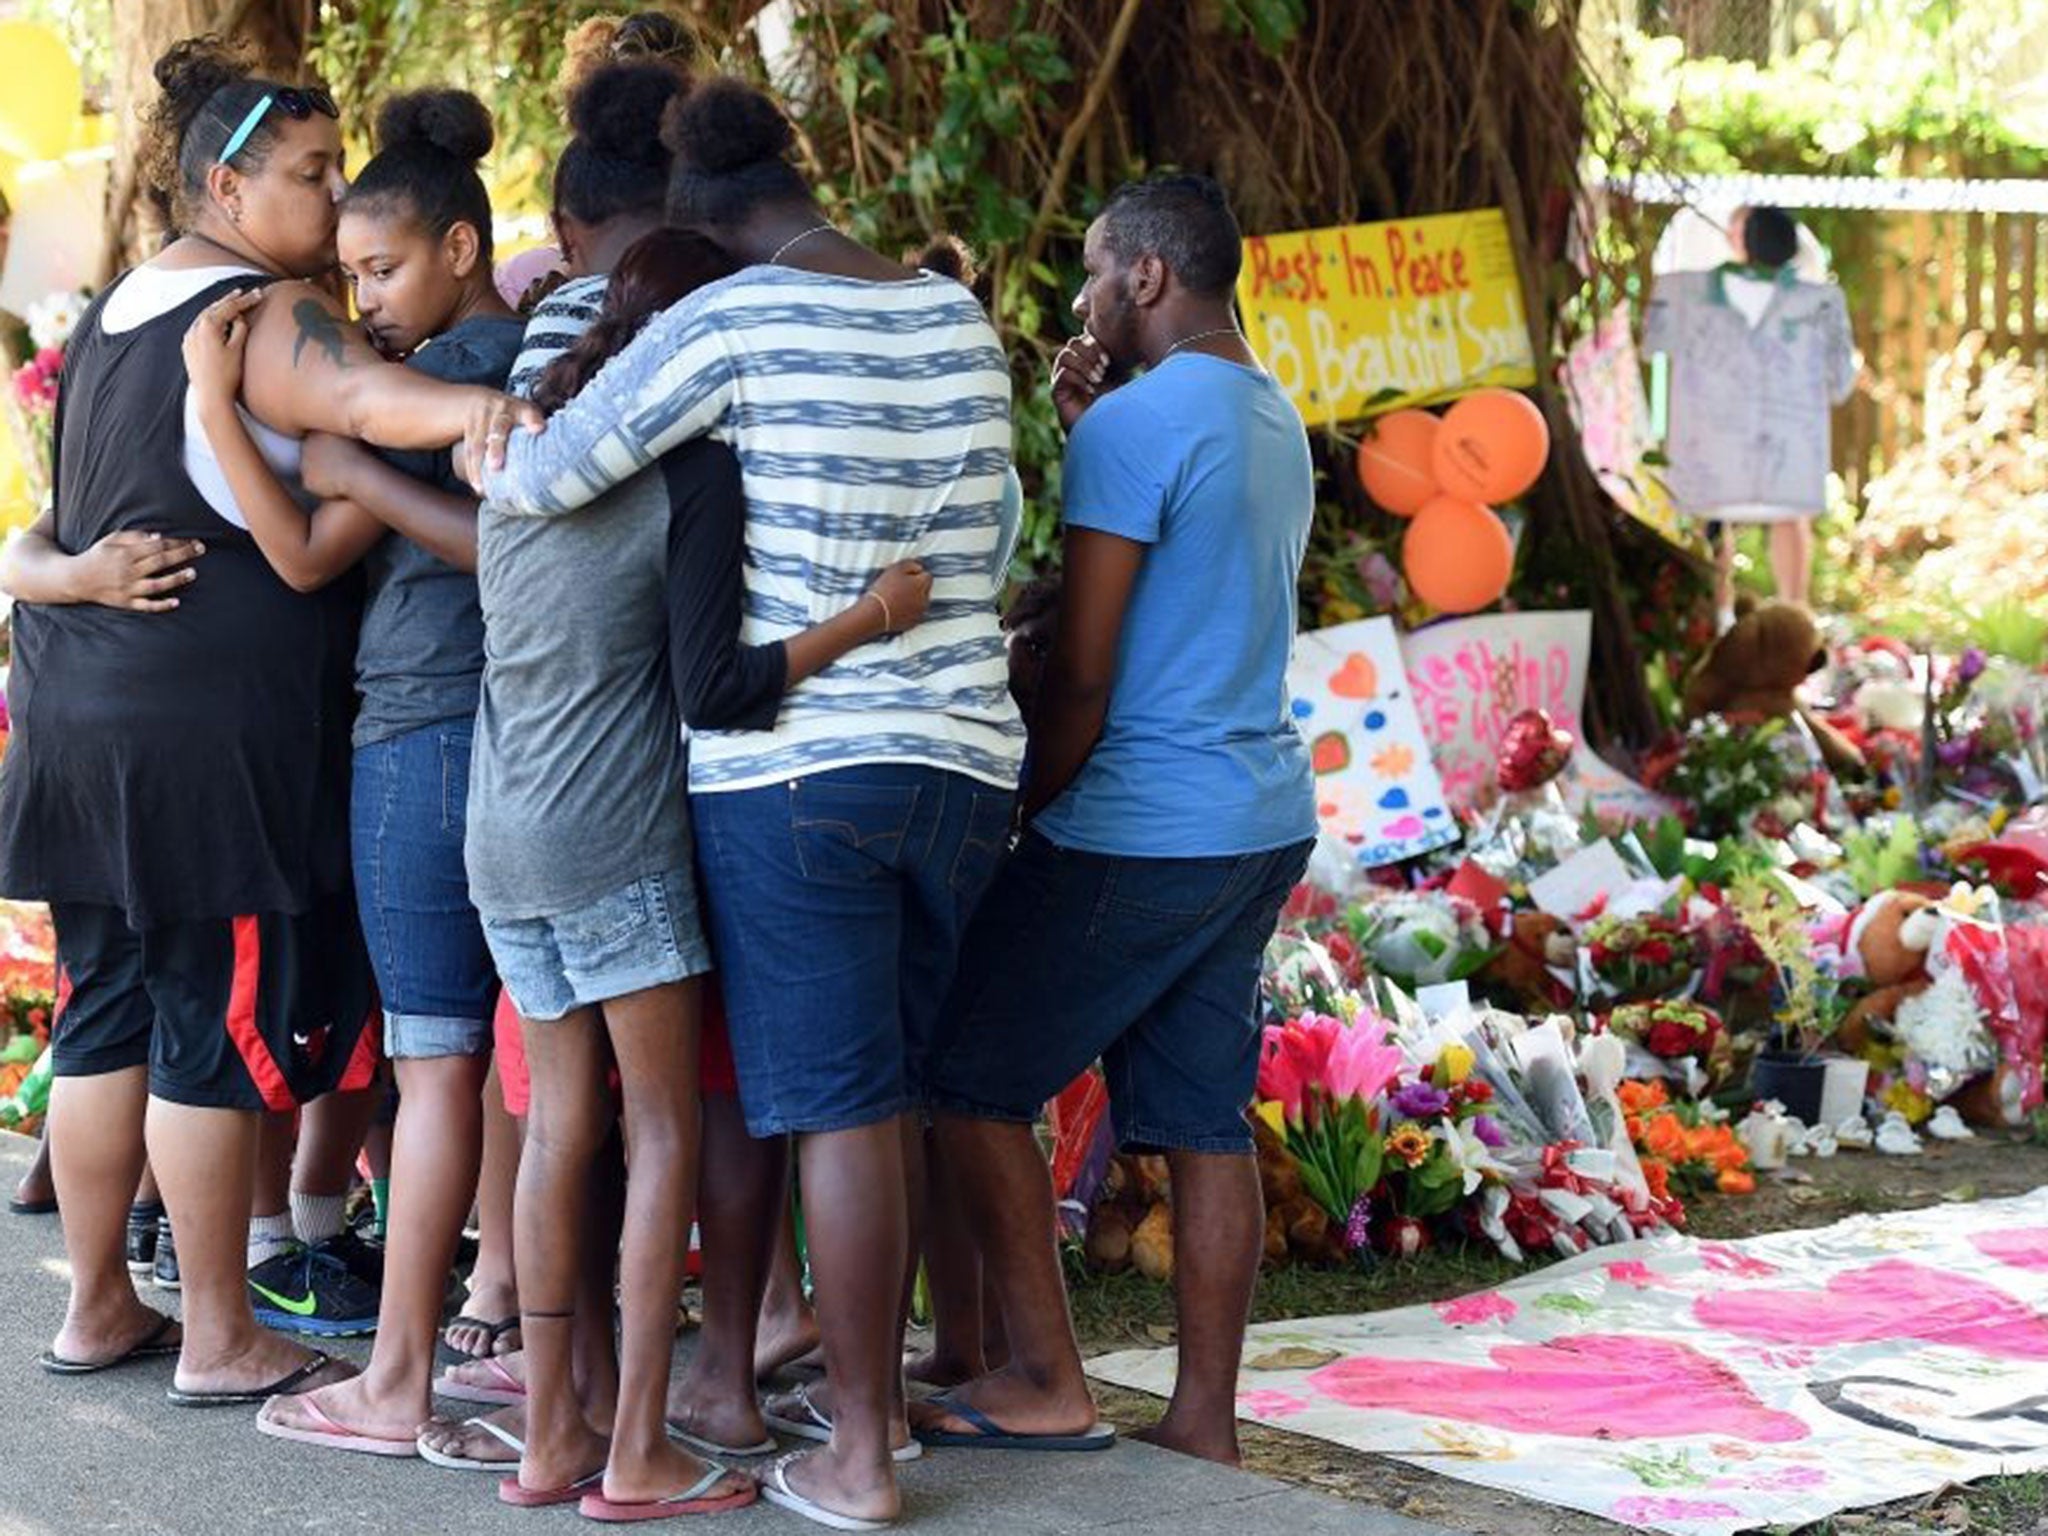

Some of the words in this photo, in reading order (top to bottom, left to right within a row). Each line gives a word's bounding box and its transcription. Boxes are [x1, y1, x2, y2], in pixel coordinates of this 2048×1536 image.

[1249, 234, 1328, 304] Rest
[1340, 231, 1382, 301] In
[1385, 221, 1470, 298] Peace
[1264, 313, 1304, 398] 8
